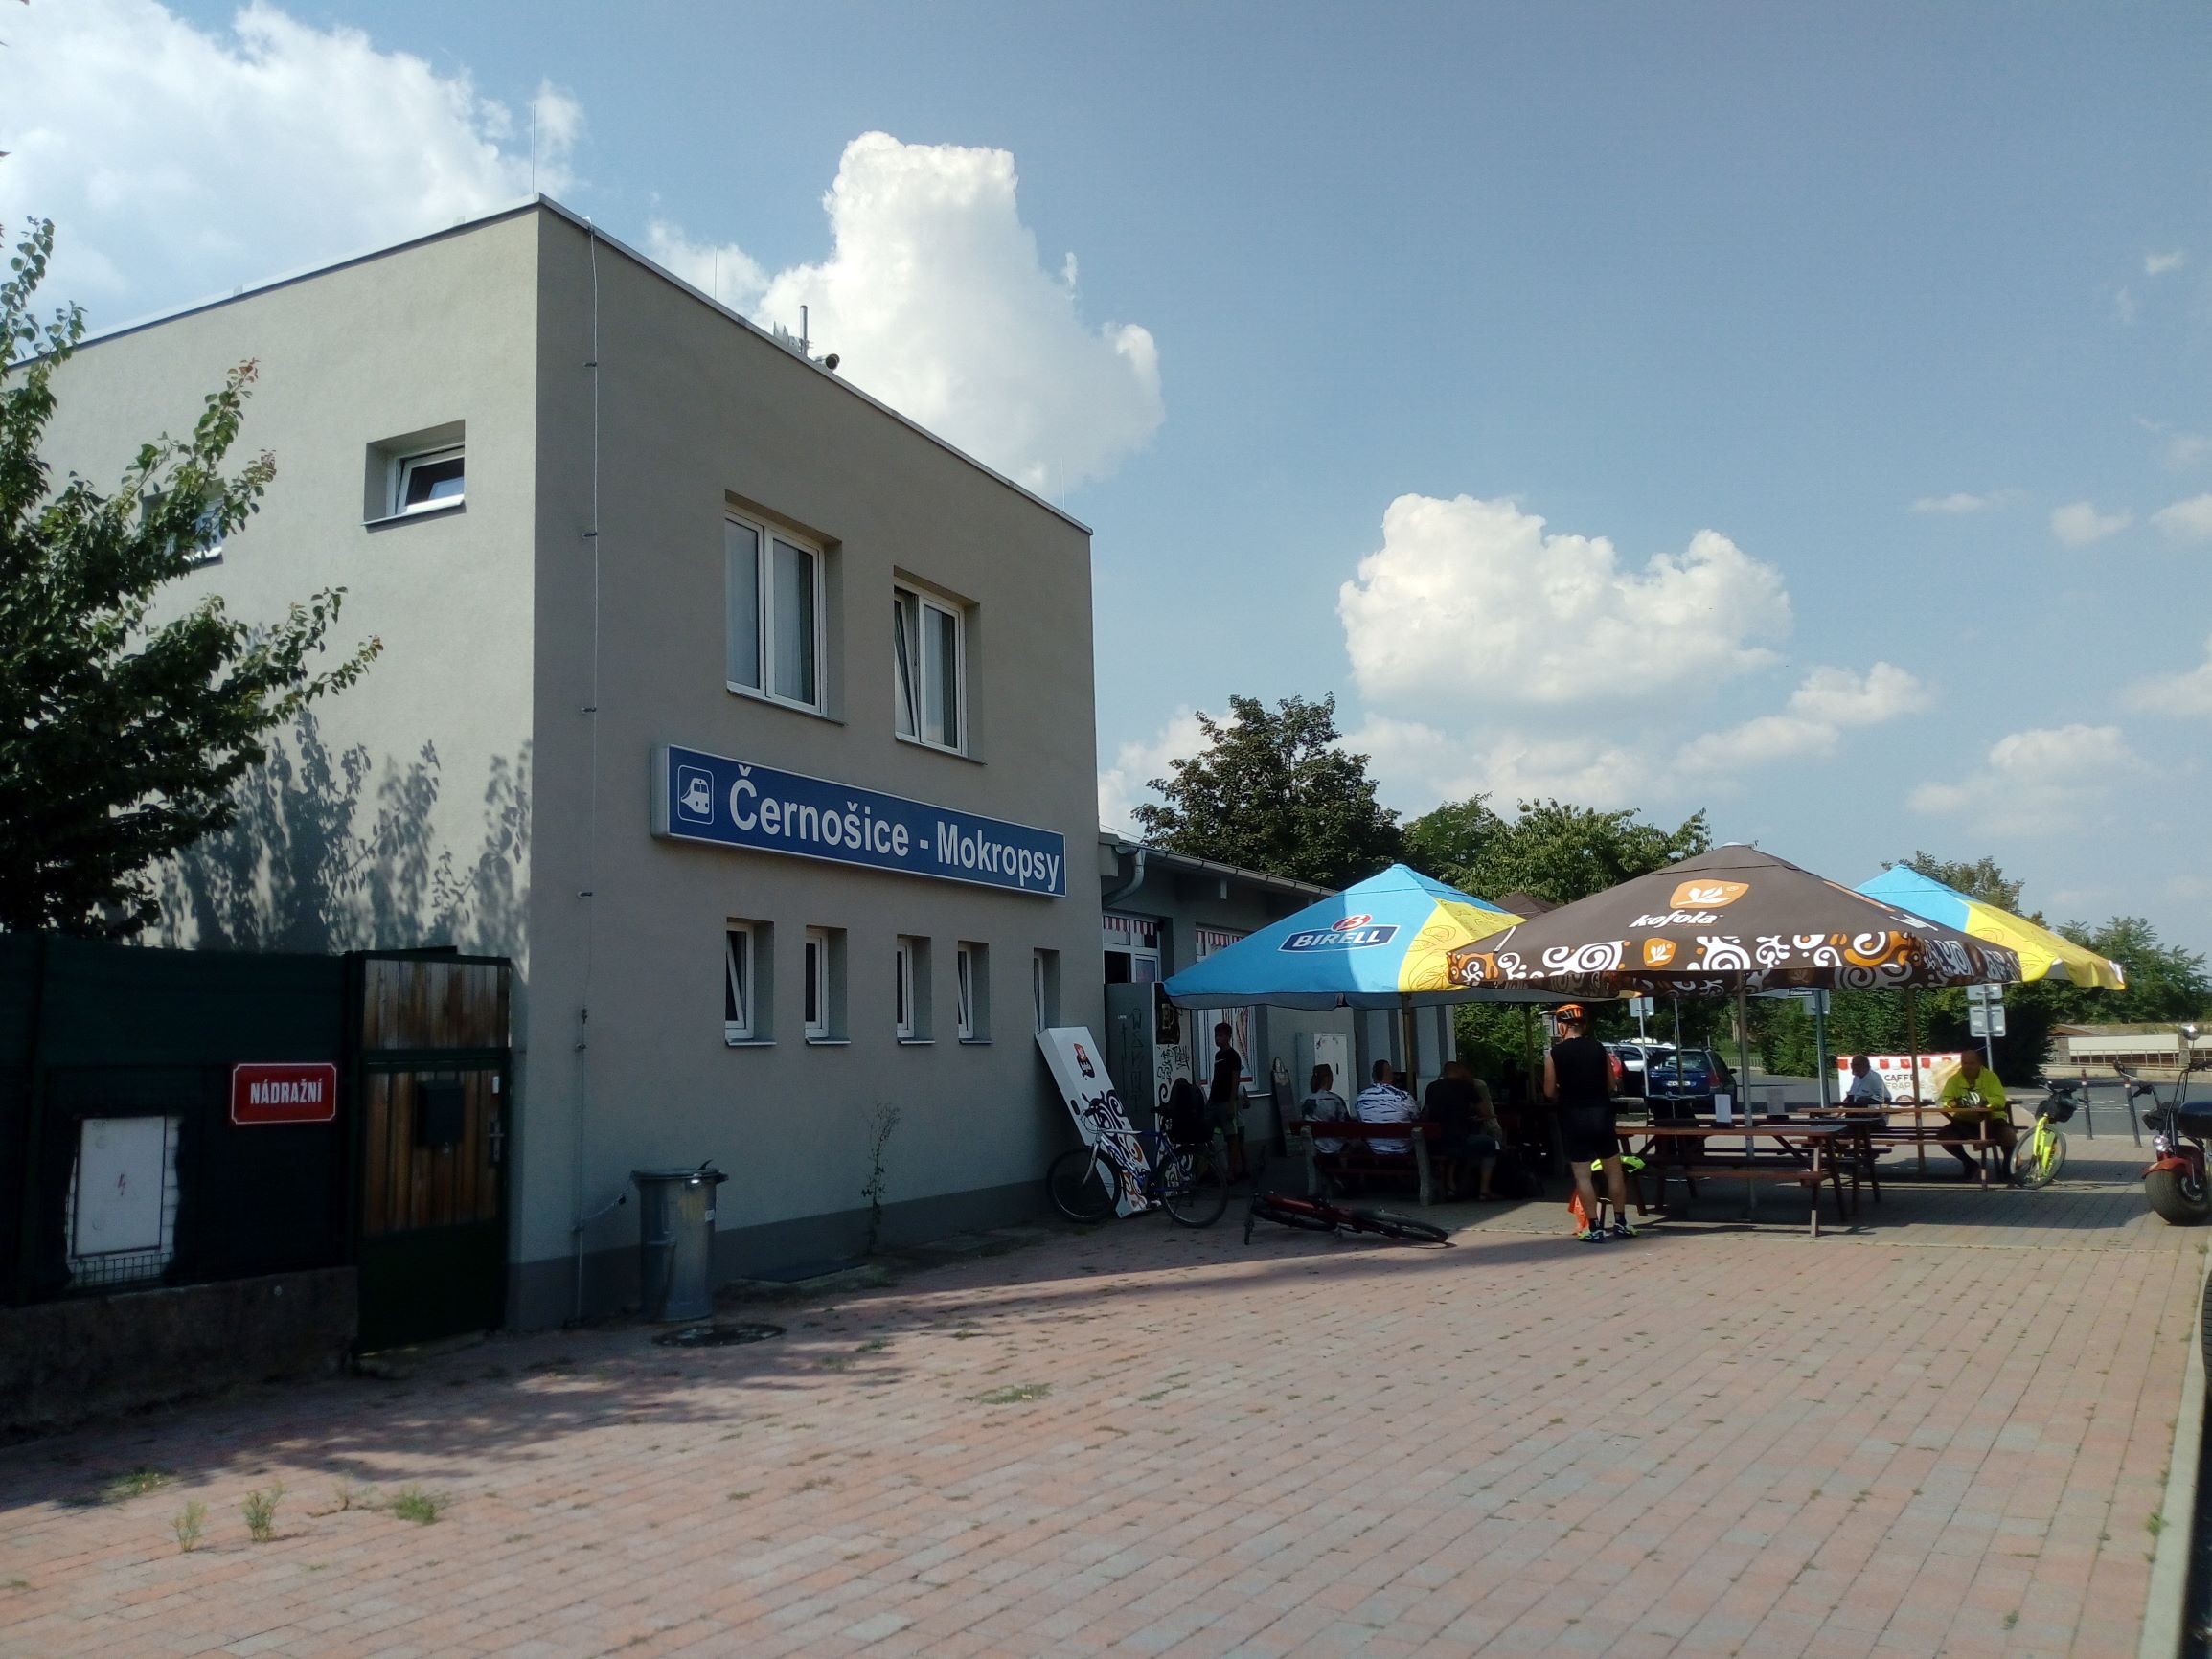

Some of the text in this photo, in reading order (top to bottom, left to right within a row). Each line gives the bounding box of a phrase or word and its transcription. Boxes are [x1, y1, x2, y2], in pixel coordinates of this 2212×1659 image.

[729, 764, 1060, 892] Černošice - Mokropsy
[1629, 909, 1718, 928] kofola
[1292, 929, 1380, 947] BIRELL
[250, 1078, 323, 1104] NÁDRAŽNÍ
[1885, 1081, 1925, 1090] FRAPE
